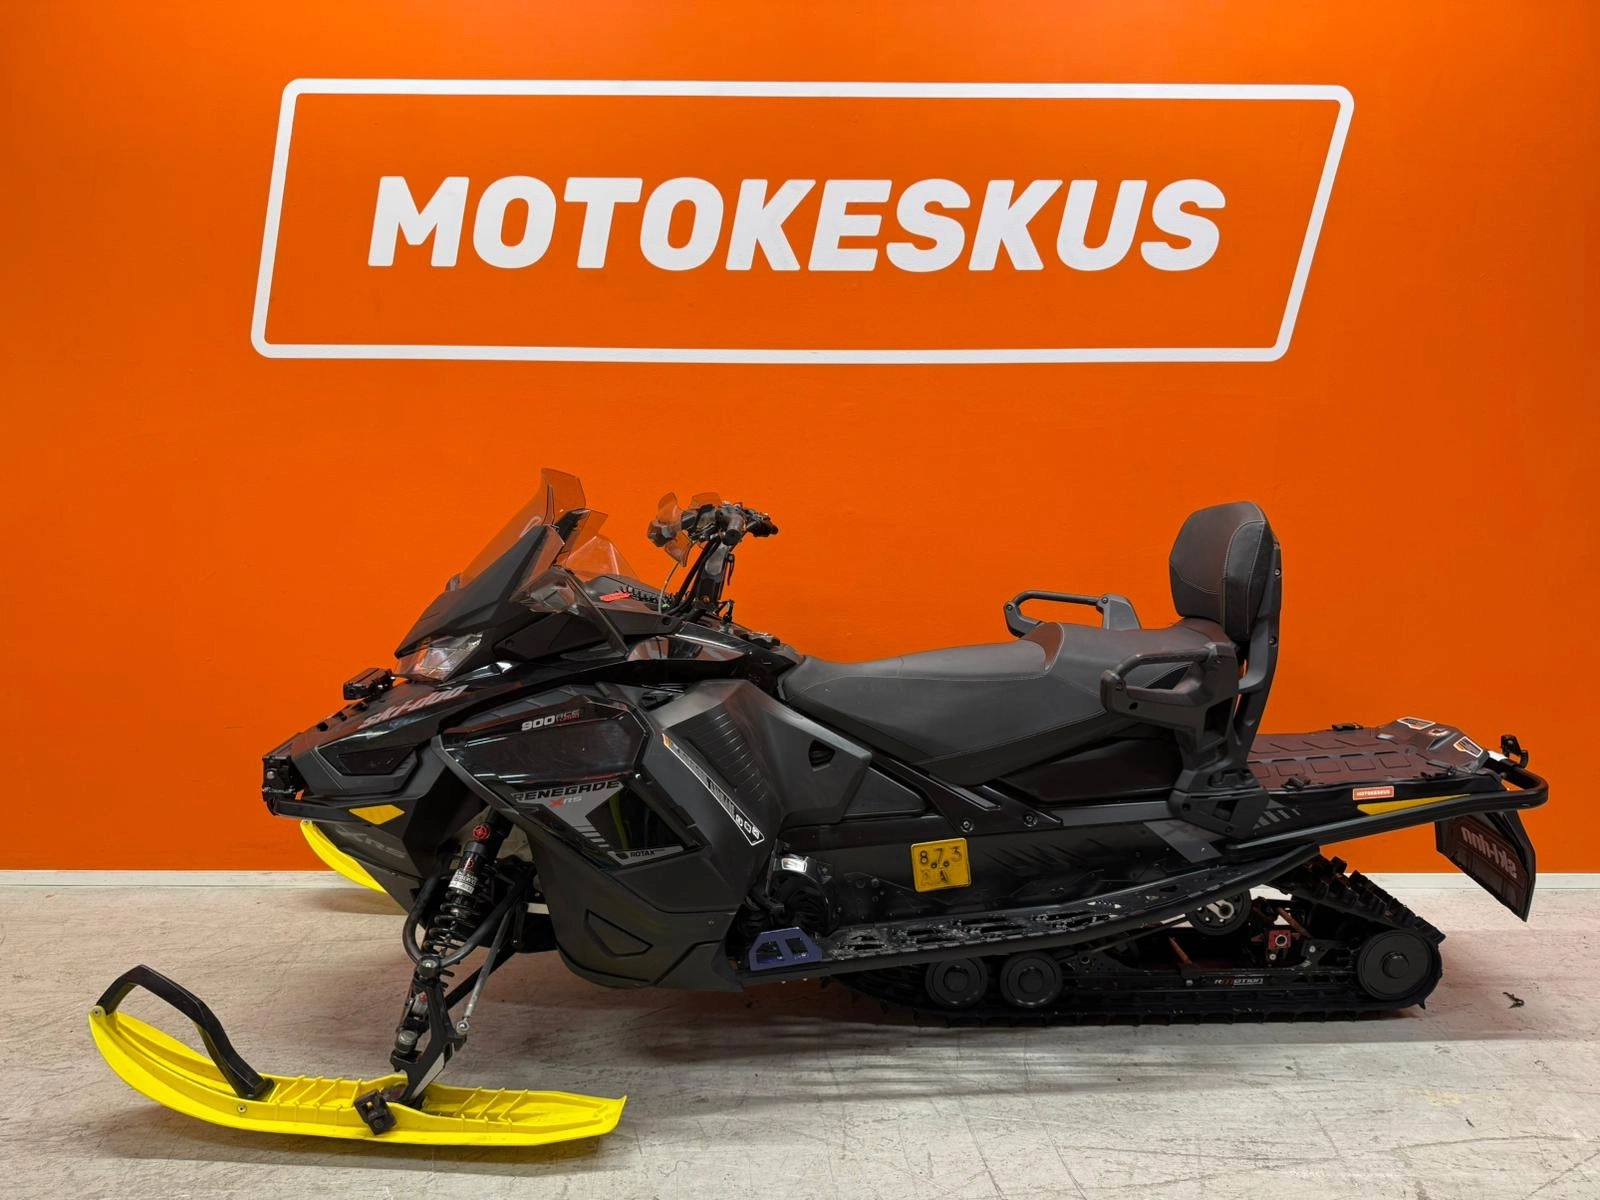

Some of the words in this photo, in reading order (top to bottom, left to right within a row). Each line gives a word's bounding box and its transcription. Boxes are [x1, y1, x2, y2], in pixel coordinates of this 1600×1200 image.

[368, 176, 1226, 272] MOTOKESKUS
[521, 715, 556, 732] 900
[512, 780, 620, 802] RENEGADE
[630, 850, 656, 858] ROTAX
[919, 845, 962, 865] 873
